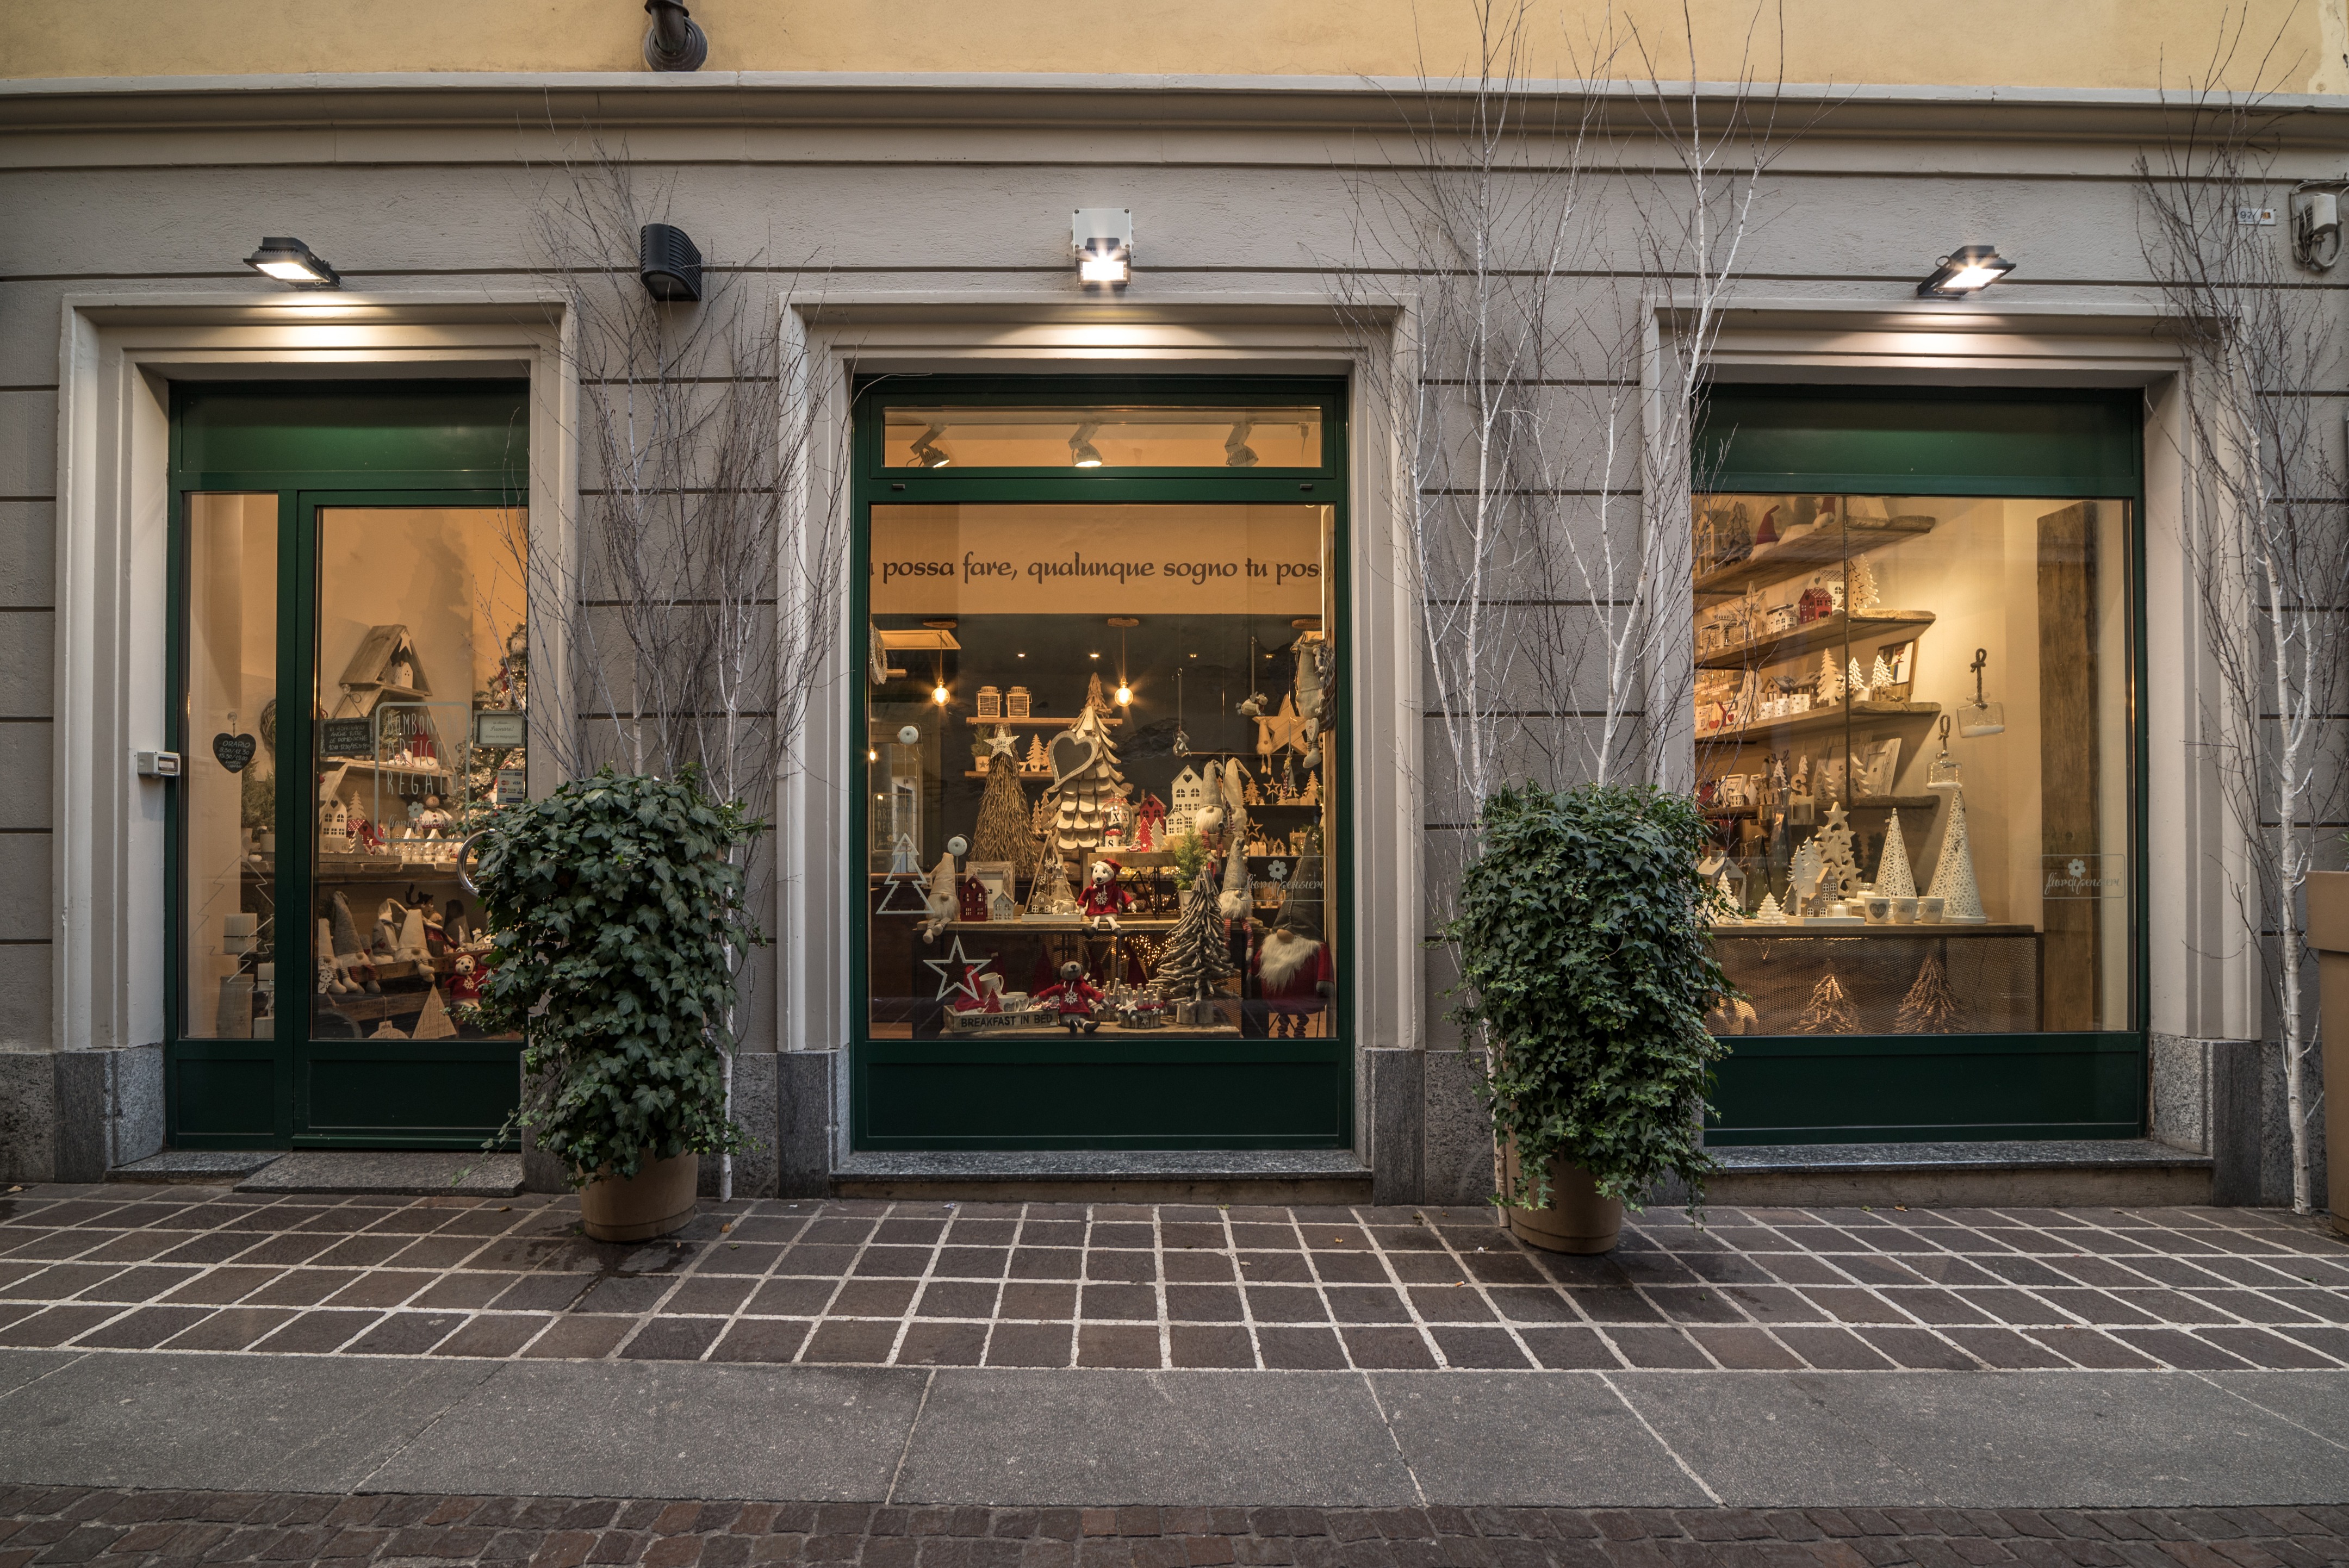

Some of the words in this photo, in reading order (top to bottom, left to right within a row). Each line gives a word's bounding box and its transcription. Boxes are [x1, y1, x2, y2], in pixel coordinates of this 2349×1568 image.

[2240, 210, 2252, 219] 97
[883, 562, 955, 584] possa
[962, 551, 1018, 584] fare,
[1027, 551, 1155, 584] qualunque
[1164, 563, 1238, 585] sogno
[1245, 557, 1268, 577] tu
[1276, 563, 1322, 586] pos
[222, 740, 251, 748] ORARIO
[387, 738, 458, 766] ARTICOLI
[387, 770, 458, 795] REGALO
[877, 808, 909, 820] ARTCOLI
[961, 1016, 1016, 1028] BREAKFAST
[1020, 1015, 1029, 1025] IN
[1034, 1014, 1053, 1023] BED
